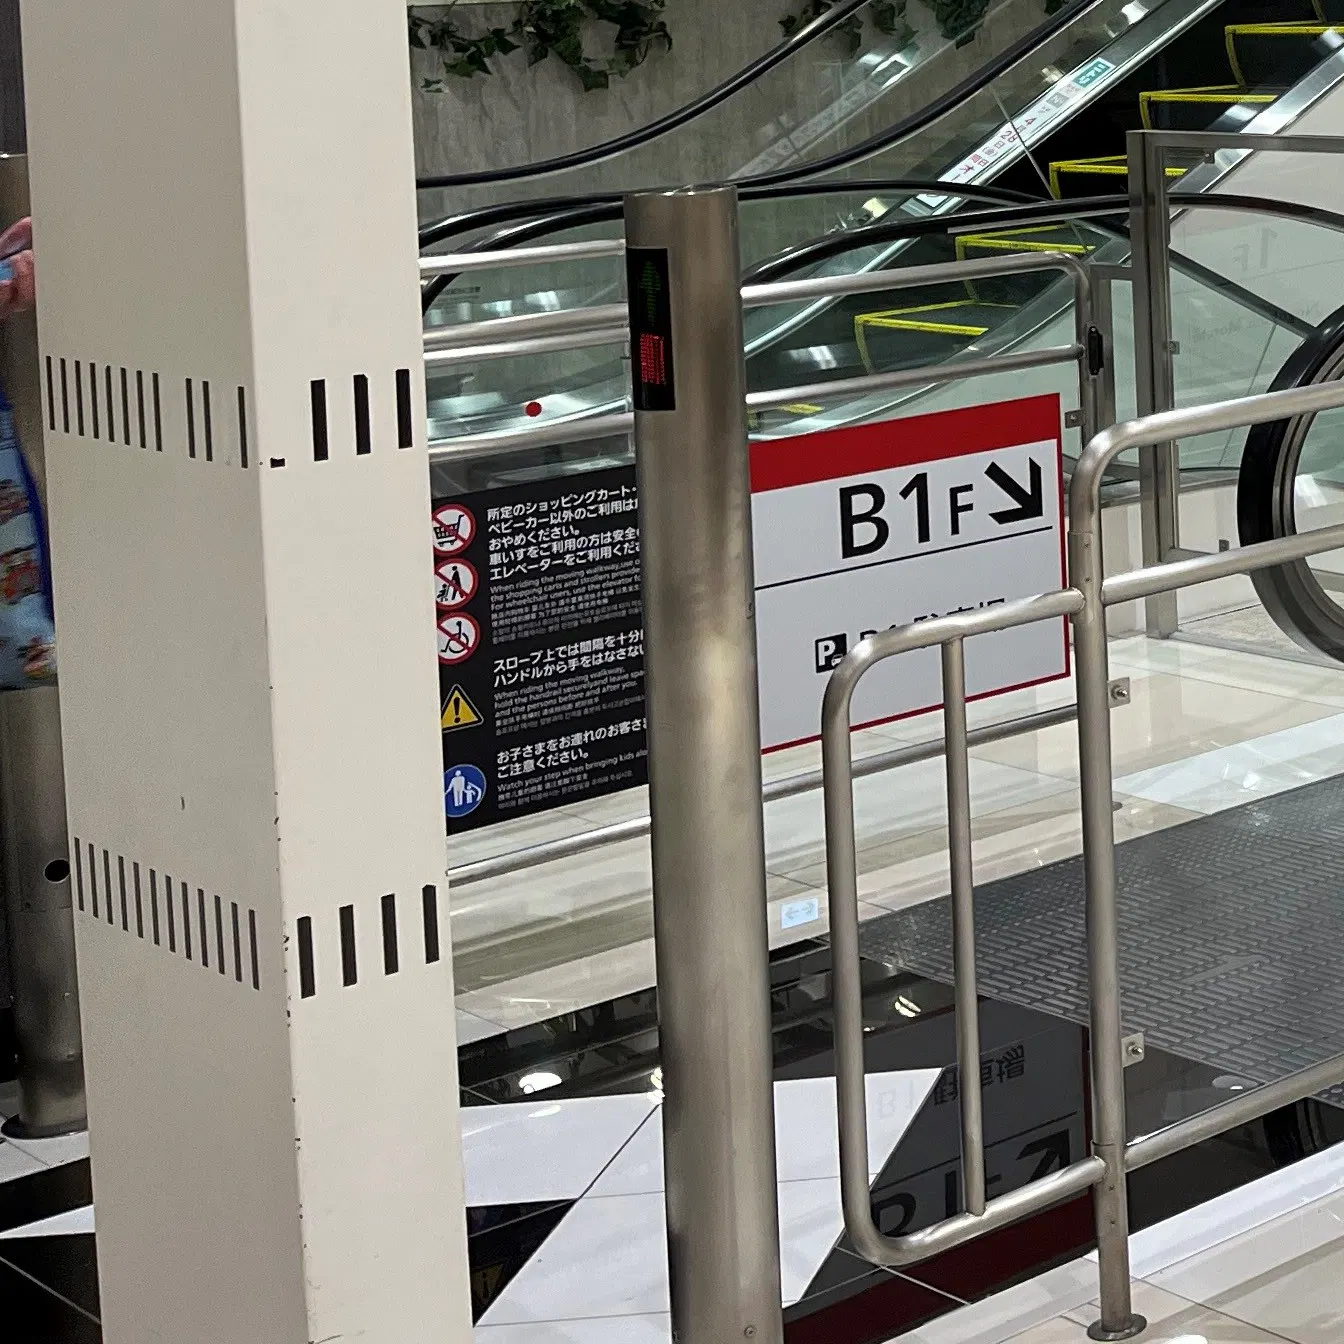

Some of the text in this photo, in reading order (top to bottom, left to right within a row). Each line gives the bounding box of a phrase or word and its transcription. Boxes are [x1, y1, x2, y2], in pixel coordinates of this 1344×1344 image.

[488, 498, 638, 534] ベビーカー以外のご利用は
[839, 473, 974, 559] B1F
[489, 525, 580, 551] おやめください。
[497, 748, 589, 779] ご注意ください。
